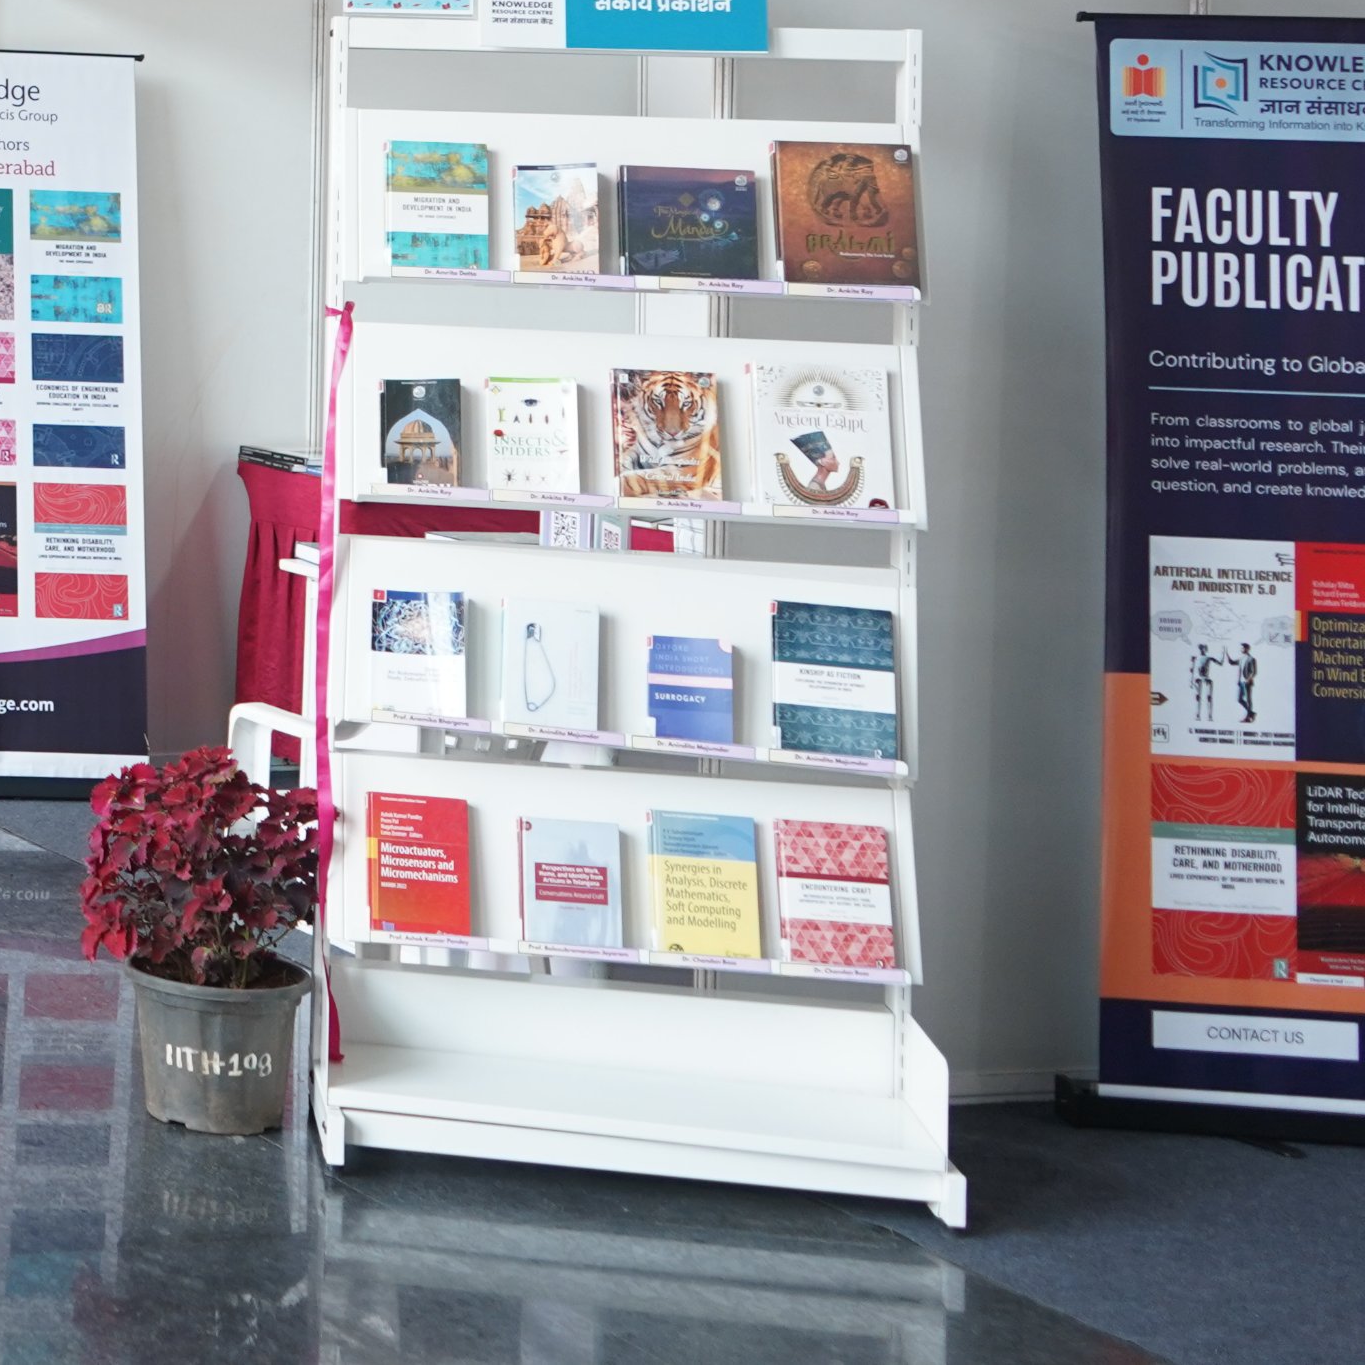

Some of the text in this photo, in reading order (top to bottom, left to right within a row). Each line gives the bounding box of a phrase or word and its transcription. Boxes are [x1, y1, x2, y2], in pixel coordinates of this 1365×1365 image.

[492, 0, 553, 9] KNOWLEDGE
[1260, 78, 1346, 91] RESOURCE
[1259, 99, 1302, 115] ज्ञान
[18, 110, 58, 125] Group
[1195, 117, 1353, 131] Transforming Information into
[403, 204, 444, 212] DEVELOPMENT
[1151, 187, 1339, 248] FACULTY
[1149, 350, 1276, 376] Contributing
[1282, 357, 1303, 372] to
[774, 411, 868, 433] Ancient Egypt
[1150, 413, 1353, 435] From classrooms to global
[494, 435, 550, 446] INSECTS
[1151, 435, 1327, 454] into impactful research.
[494, 447, 550, 456] SPIDERS
[1151, 457, 1350, 477] solve real-world problems,
[1151, 479, 1303, 496] question, and create
[1154, 565, 1293, 583] ARTIFICIAL INTELLIGENCE
[1171, 580, 1277, 596] AND INDUSTRY 5.0
[655, 644, 688, 652] OXFORD
[682, 655, 710, 663] SHORT
[1313, 650, 1363, 666] Machine
[800, 668, 862, 680] KINSHIP FICTION
[1313, 667, 1358, 682] in Wind
[655, 692, 706, 703] SURROGACY
[1307, 786, 1343, 799] LiDAR
[1307, 801, 1324, 813] for
[381, 842, 447, 859] Microactuators,
[1174, 845, 1281, 861] RETHINKING DISABILITY,
[381, 854, 455, 871] Microsensors and
[542, 864, 575, 873] Perspectives
[664, 860, 722, 875] Synergies in
[1173, 859, 1282, 873] CARE, AND MOTHERHOOD
[381, 867, 458, 884] Micromechanisms
[666, 874, 748, 891] Analysis, Discrete
[666, 888, 730, 903] Mathematics,
[801, 883, 872, 895] ENCOUNTERING CRAFT
[666, 901, 741, 919] Soft Computing
[666, 916, 736, 933] and Modelling
[1207, 1026, 1305, 1045] CONTACT US
